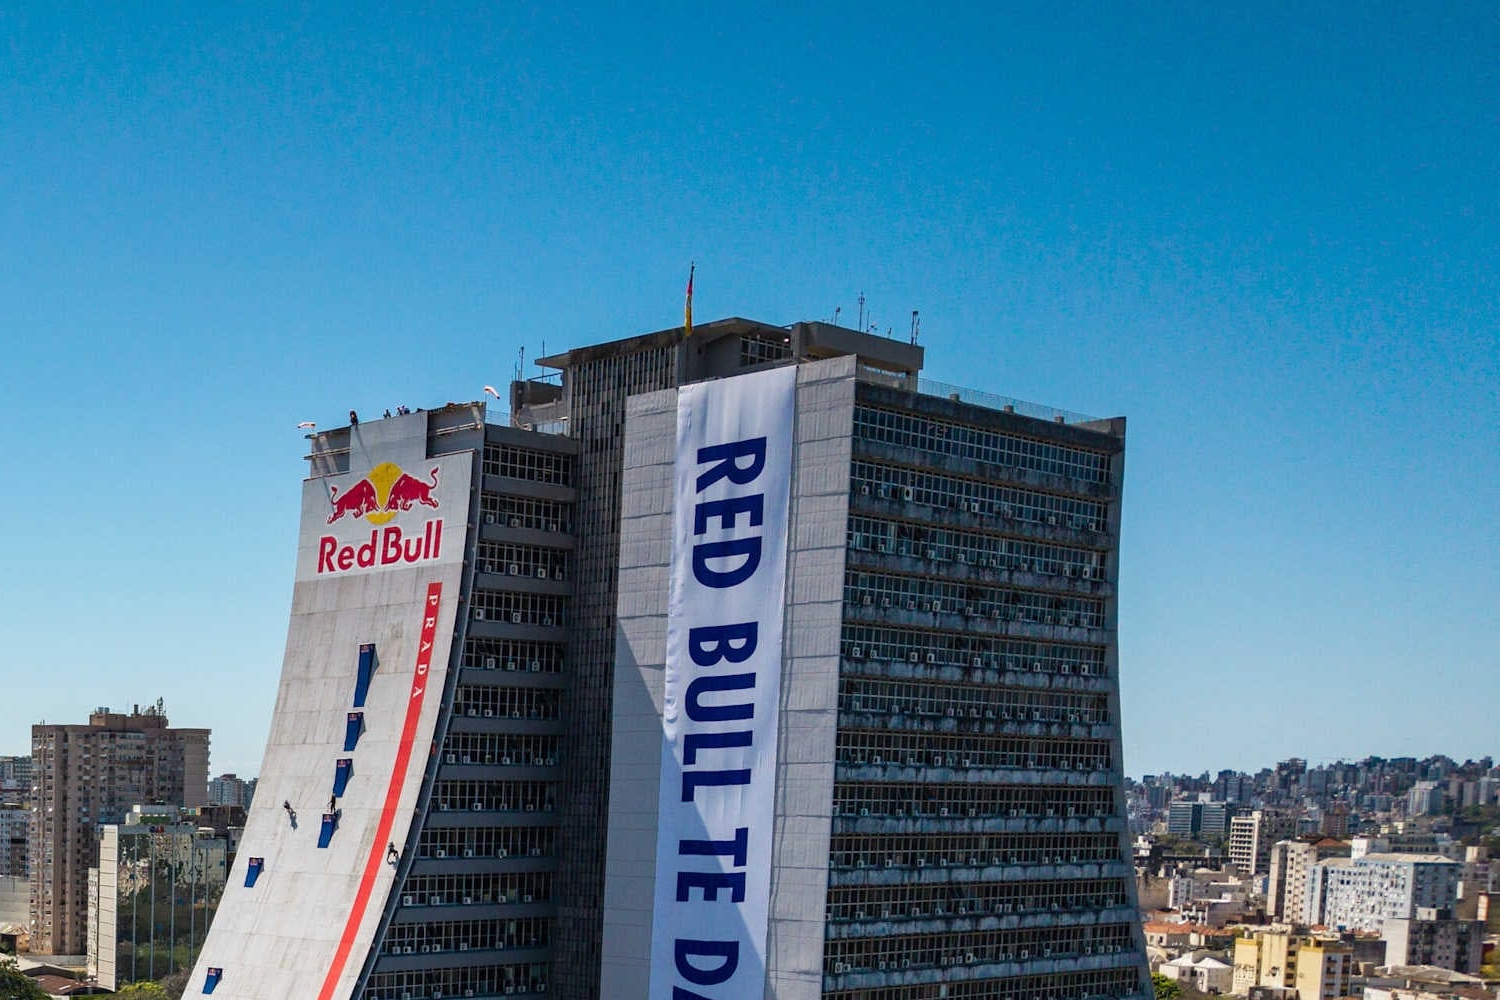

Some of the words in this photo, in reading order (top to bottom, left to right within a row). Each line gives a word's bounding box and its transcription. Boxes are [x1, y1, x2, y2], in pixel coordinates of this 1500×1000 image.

[691, 437, 767, 588] RED
[413, 594, 438, 698] PRADA
[681, 621, 758, 802] BULL
[675, 827, 748, 903] TE
